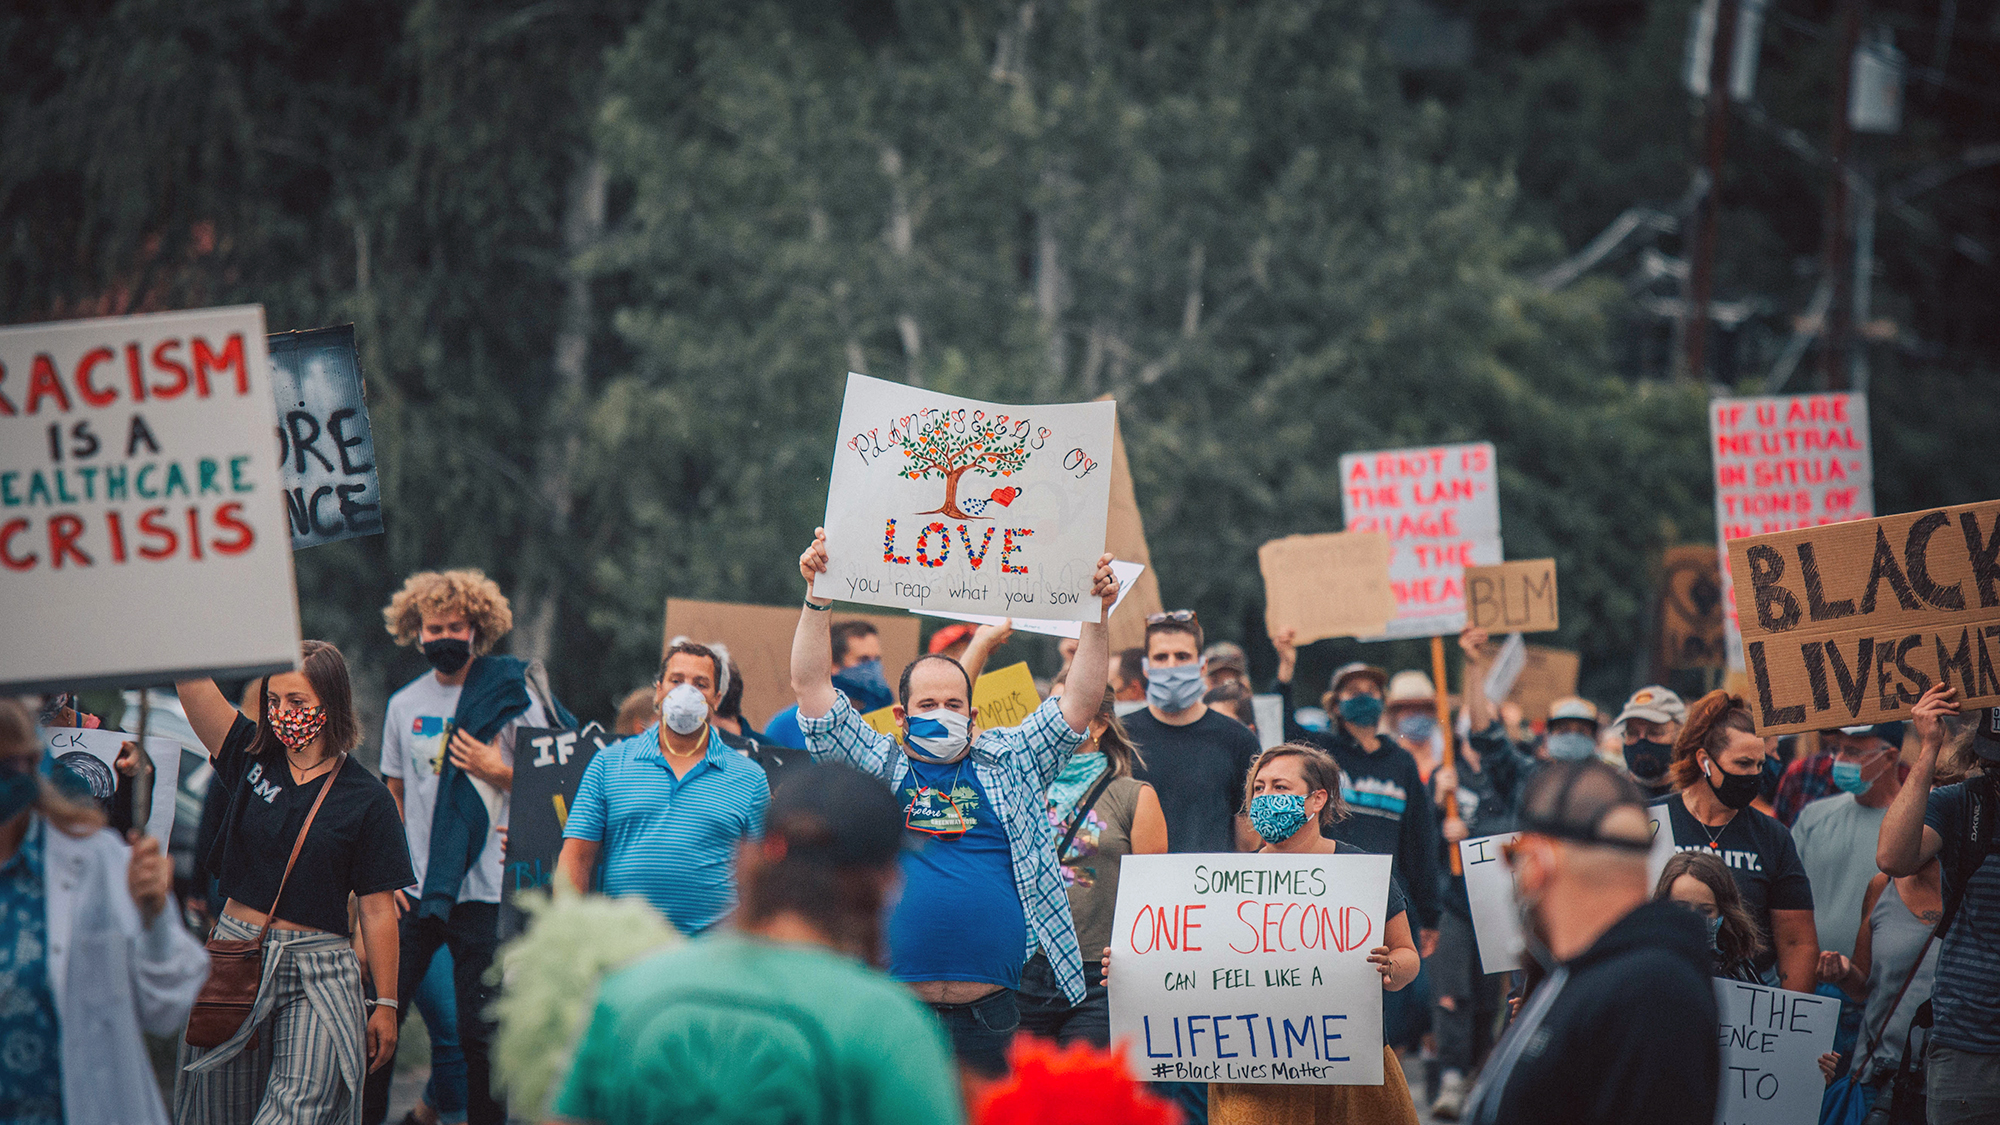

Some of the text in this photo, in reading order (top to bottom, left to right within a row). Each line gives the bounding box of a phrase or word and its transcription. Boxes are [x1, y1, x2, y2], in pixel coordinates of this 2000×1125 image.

[1718, 394, 1850, 428] IF U ARE
[48, 413, 160, 462] IS A
[847, 408, 939, 466] PLANT
[951, 408, 1052, 450] SEEDS
[1718, 428, 1863, 457] NEUTRAL
[1350, 444, 1488, 482] A RIOT IS
[1718, 455, 1861, 488] IN SITUA-
[1348, 484, 1400, 509] THE
[1723, 487, 1859, 517] TIONS OF
[0, 502, 255, 572] CRISIS
[883, 518, 1035, 575] LOVE
[1415, 540, 1474, 569] THE
[1746, 511, 2000, 633] BLACK
[846, 577, 1080, 611] you reap what you sow
[1390, 576, 1465, 605] NHEA
[1470, 571, 1555, 629] BLM
[1749, 633, 1933, 728] LIVES
[51, 732, 88, 749] CK
[531, 731, 577, 768] IF
[1971, 804, 1981, 842] DAKINE
[1194, 865, 1326, 896] SOMETIMES
[1131, 900, 1372, 954] ONE SECOND
[1164, 966, 1323, 991] CAN FEEL LIKE A
[1736, 984, 1823, 1034] THE
[1144, 1013, 1350, 1061] LIFETIME
[1718, 1023, 1779, 1053] ENCE
[1728, 1066, 1779, 1100] TO
